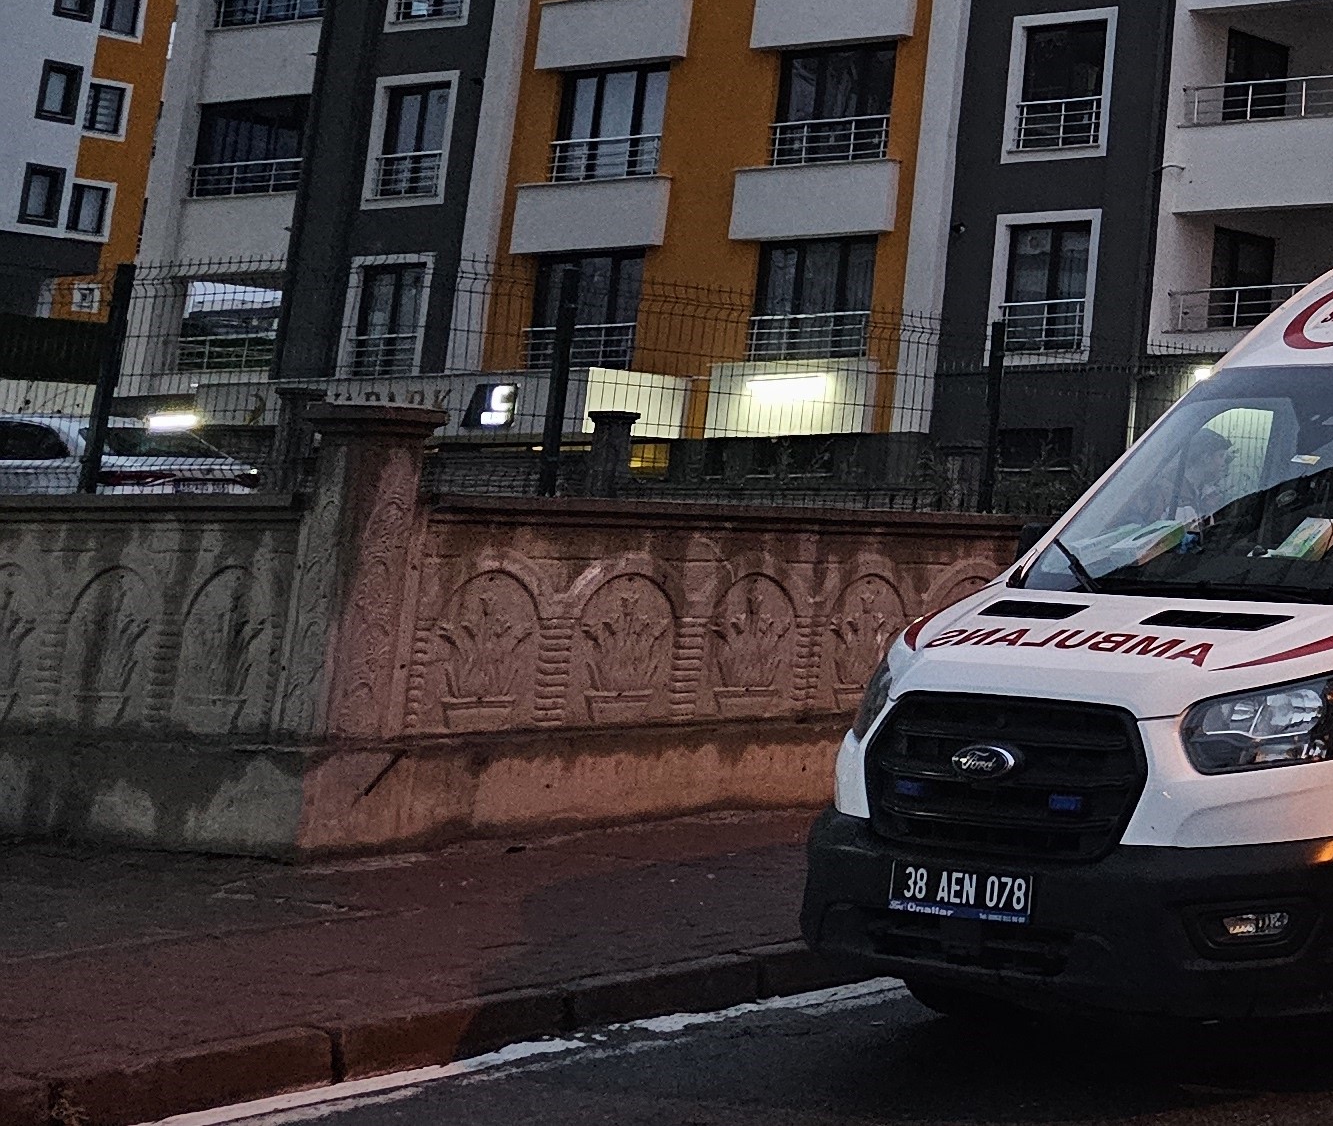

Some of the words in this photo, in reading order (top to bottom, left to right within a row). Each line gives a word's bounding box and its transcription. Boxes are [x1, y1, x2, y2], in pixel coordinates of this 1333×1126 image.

[960, 750, 997, 772] Ford
[903, 866, 928, 899] 38
[936, 871, 977, 905] AEN
[985, 876, 1026, 910] 078
